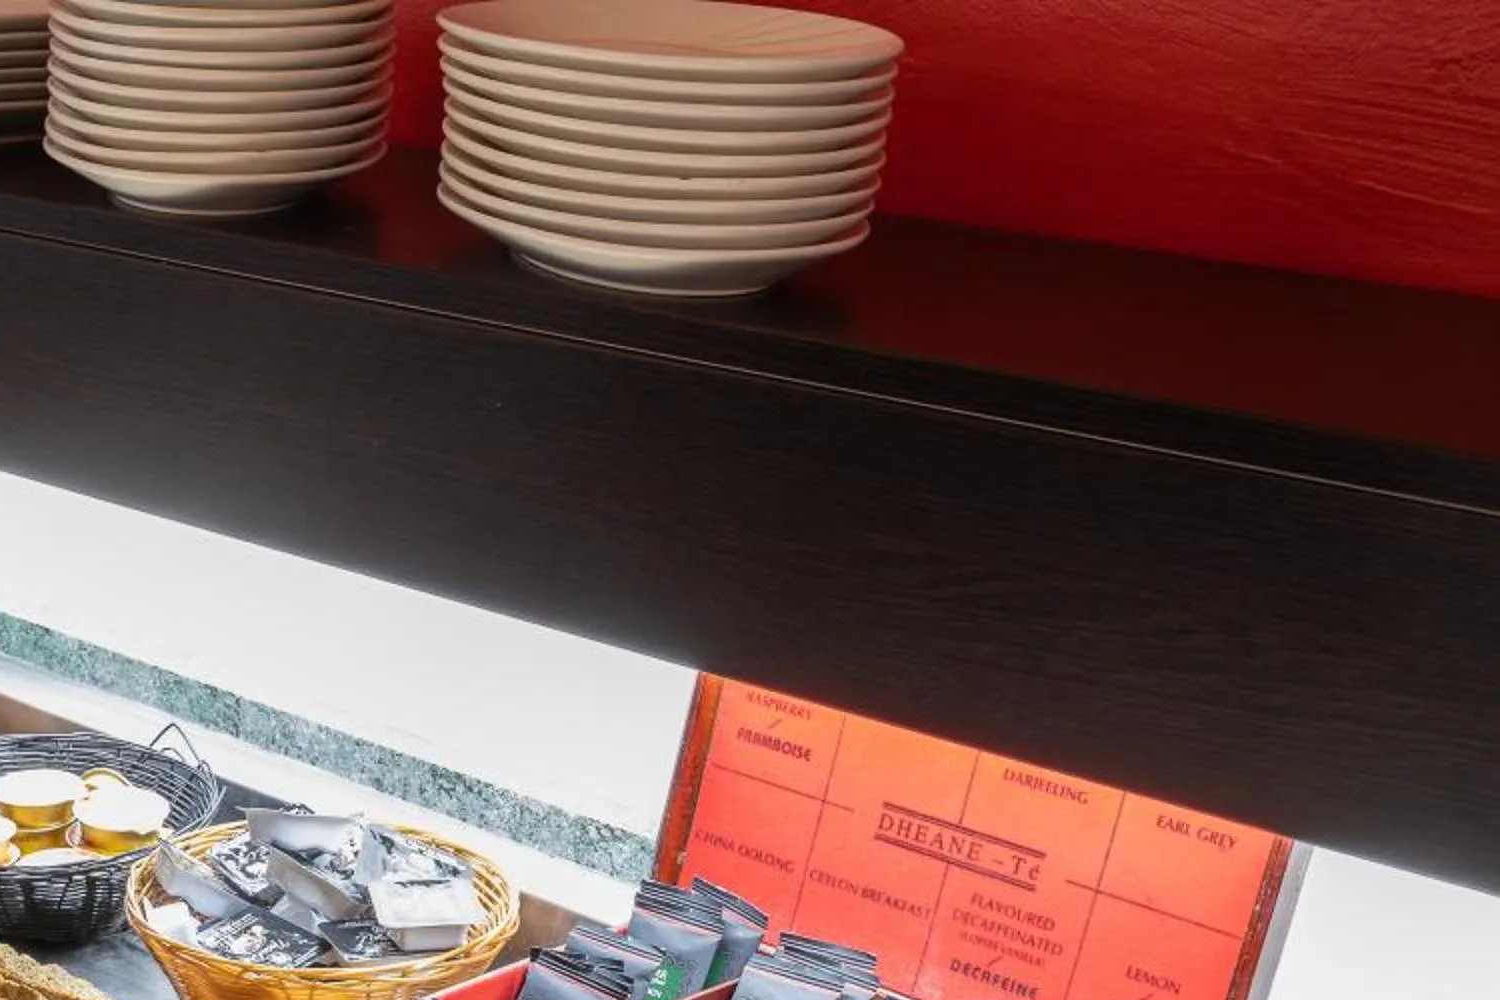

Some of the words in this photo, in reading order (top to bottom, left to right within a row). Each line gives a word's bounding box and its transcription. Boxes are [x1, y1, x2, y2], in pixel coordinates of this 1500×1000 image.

[735, 726, 813, 763] FRAMBOISE
[1002, 766, 1089, 805] DARJEELING
[877, 811, 984, 862] DHEANE
[1155, 814, 1191, 838] EARL
[1195, 826, 1238, 849] GREY
[736, 842, 796, 874] OOLONG
[859, 885, 933, 921] BREAKFAST
[970, 891, 1056, 932] FLAVOURED
[1125, 963, 1182, 996] LEMON
